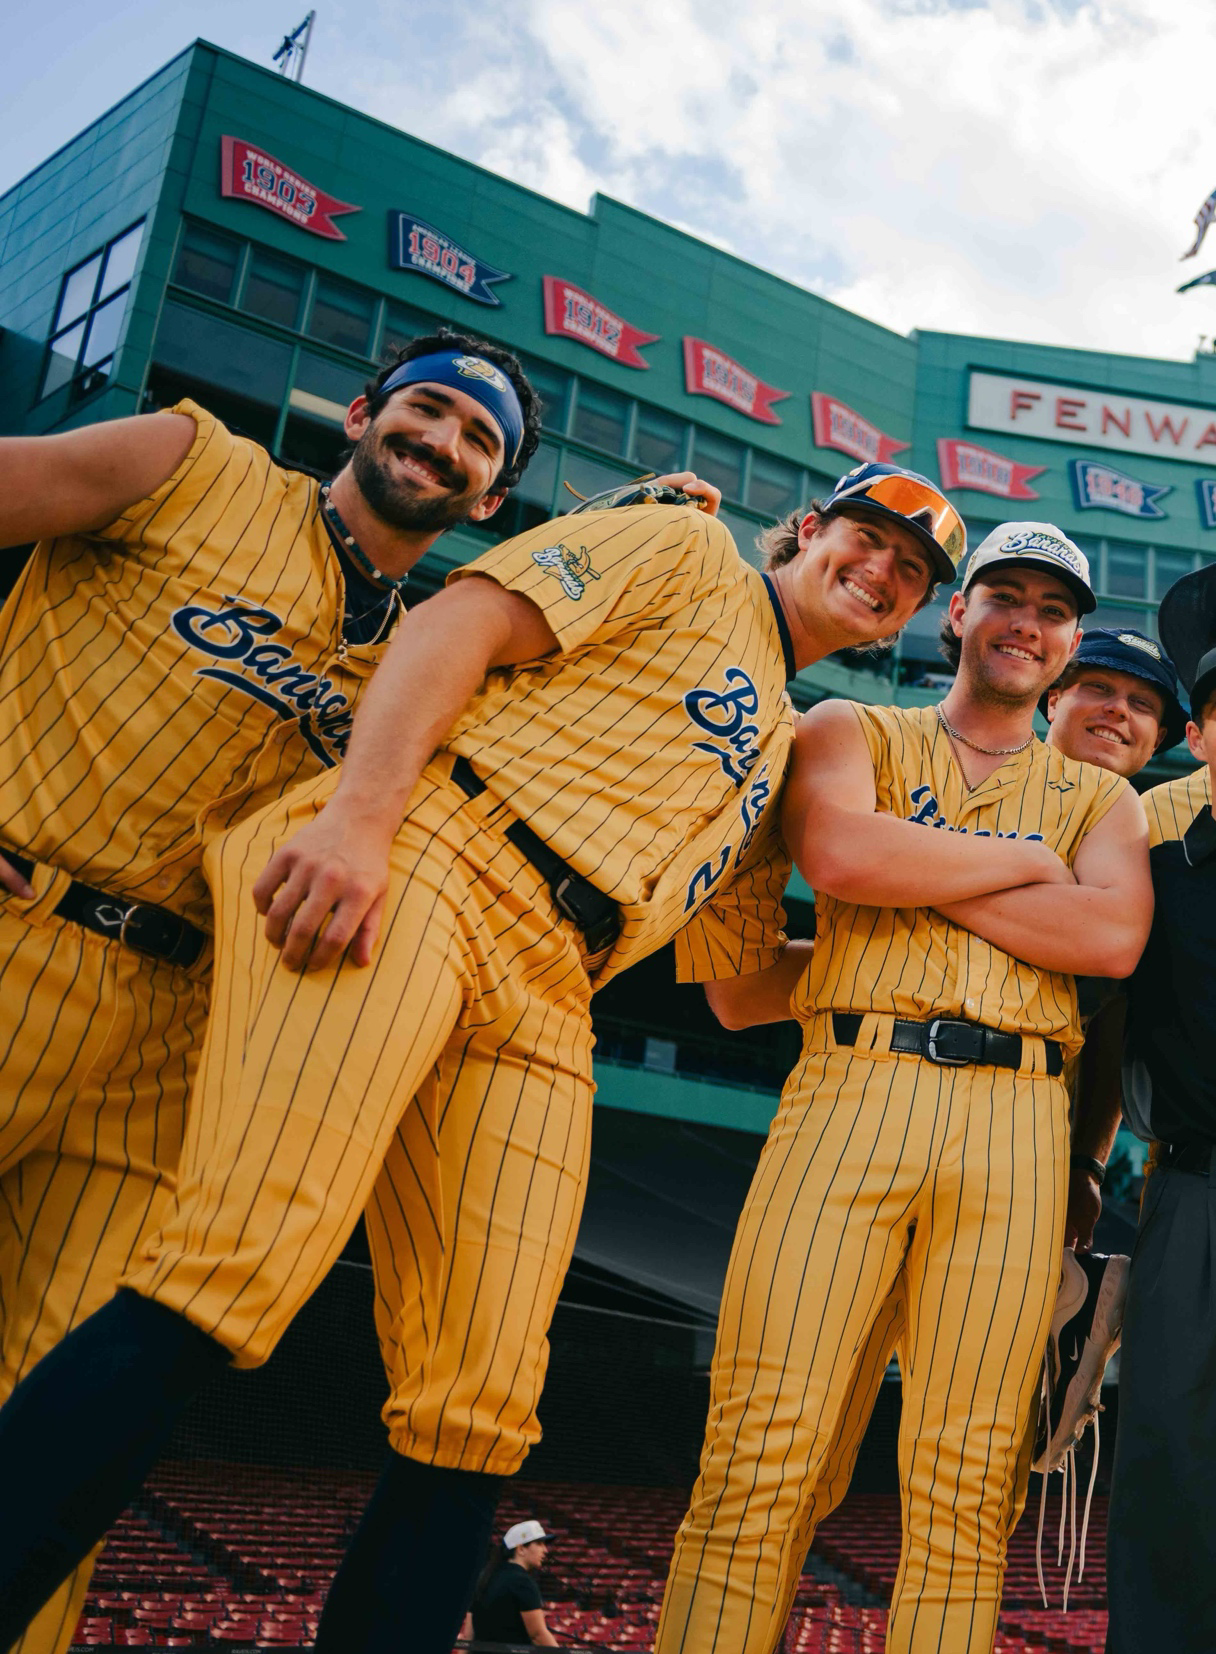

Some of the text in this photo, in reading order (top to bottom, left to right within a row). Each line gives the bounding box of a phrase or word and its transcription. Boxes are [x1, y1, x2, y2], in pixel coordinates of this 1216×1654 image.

[246, 150, 283, 175] WORLD
[242, 160, 317, 217] 1903
[244, 181, 309, 224] CHAMPIONS
[409, 231, 476, 285] 1904
[565, 299, 620, 348] 1912
[1000, 530, 1083, 579] Bananas
